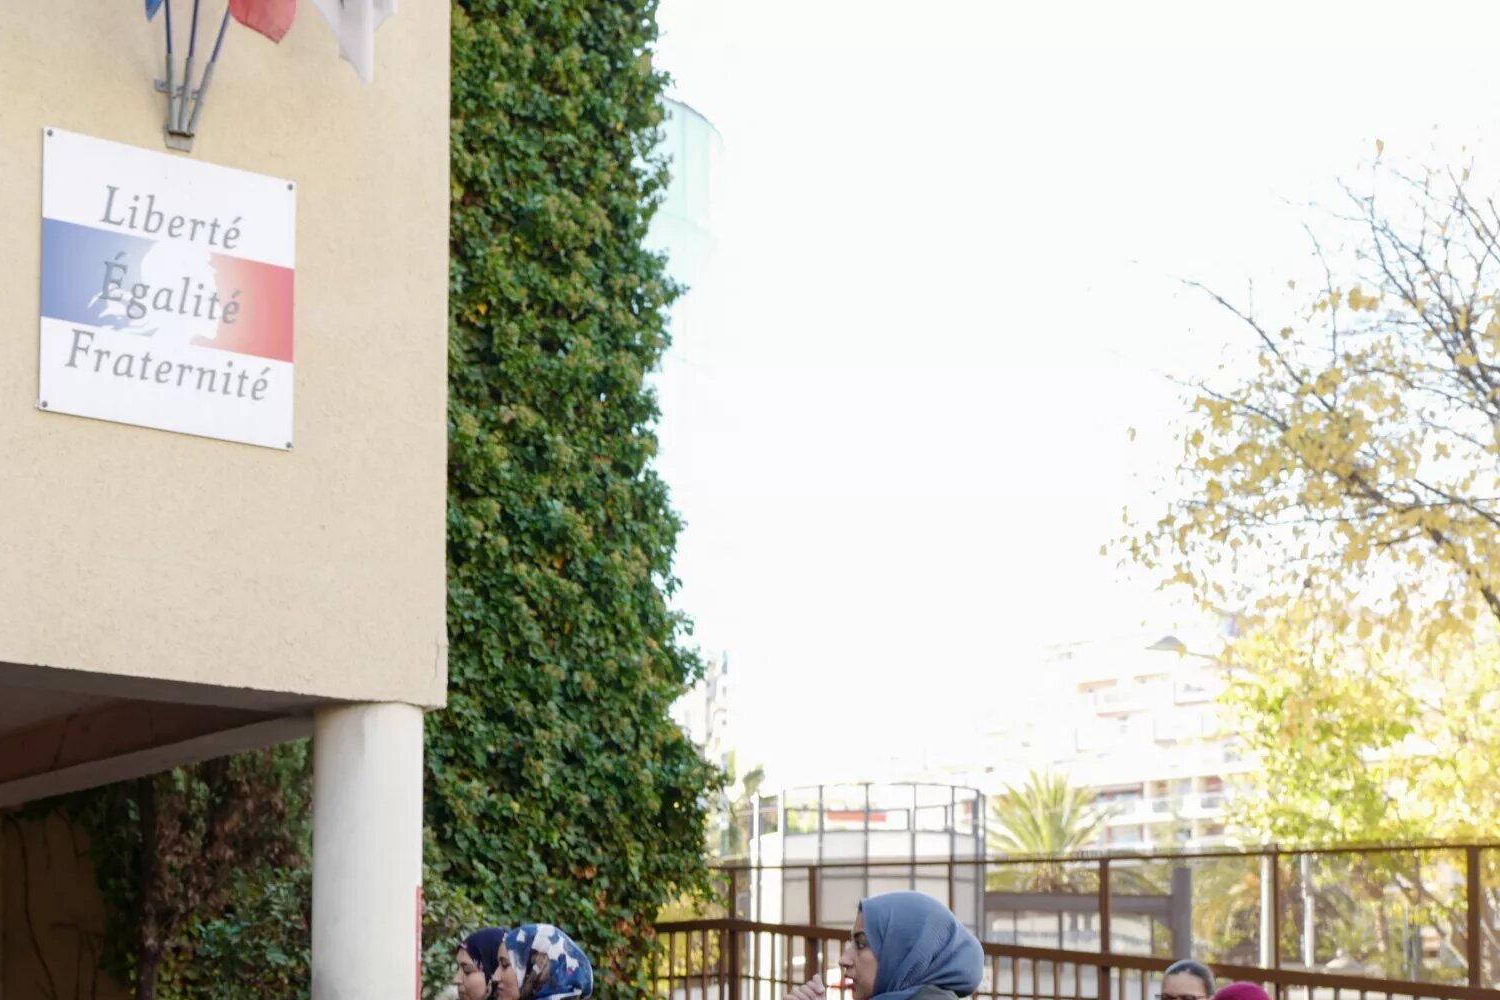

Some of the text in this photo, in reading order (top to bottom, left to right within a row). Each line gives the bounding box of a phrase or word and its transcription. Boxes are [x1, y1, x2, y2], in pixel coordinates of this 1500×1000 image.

[100, 184, 243, 250] Liberté
[100, 251, 243, 324] Égalité
[64, 328, 271, 401] Fraternité
